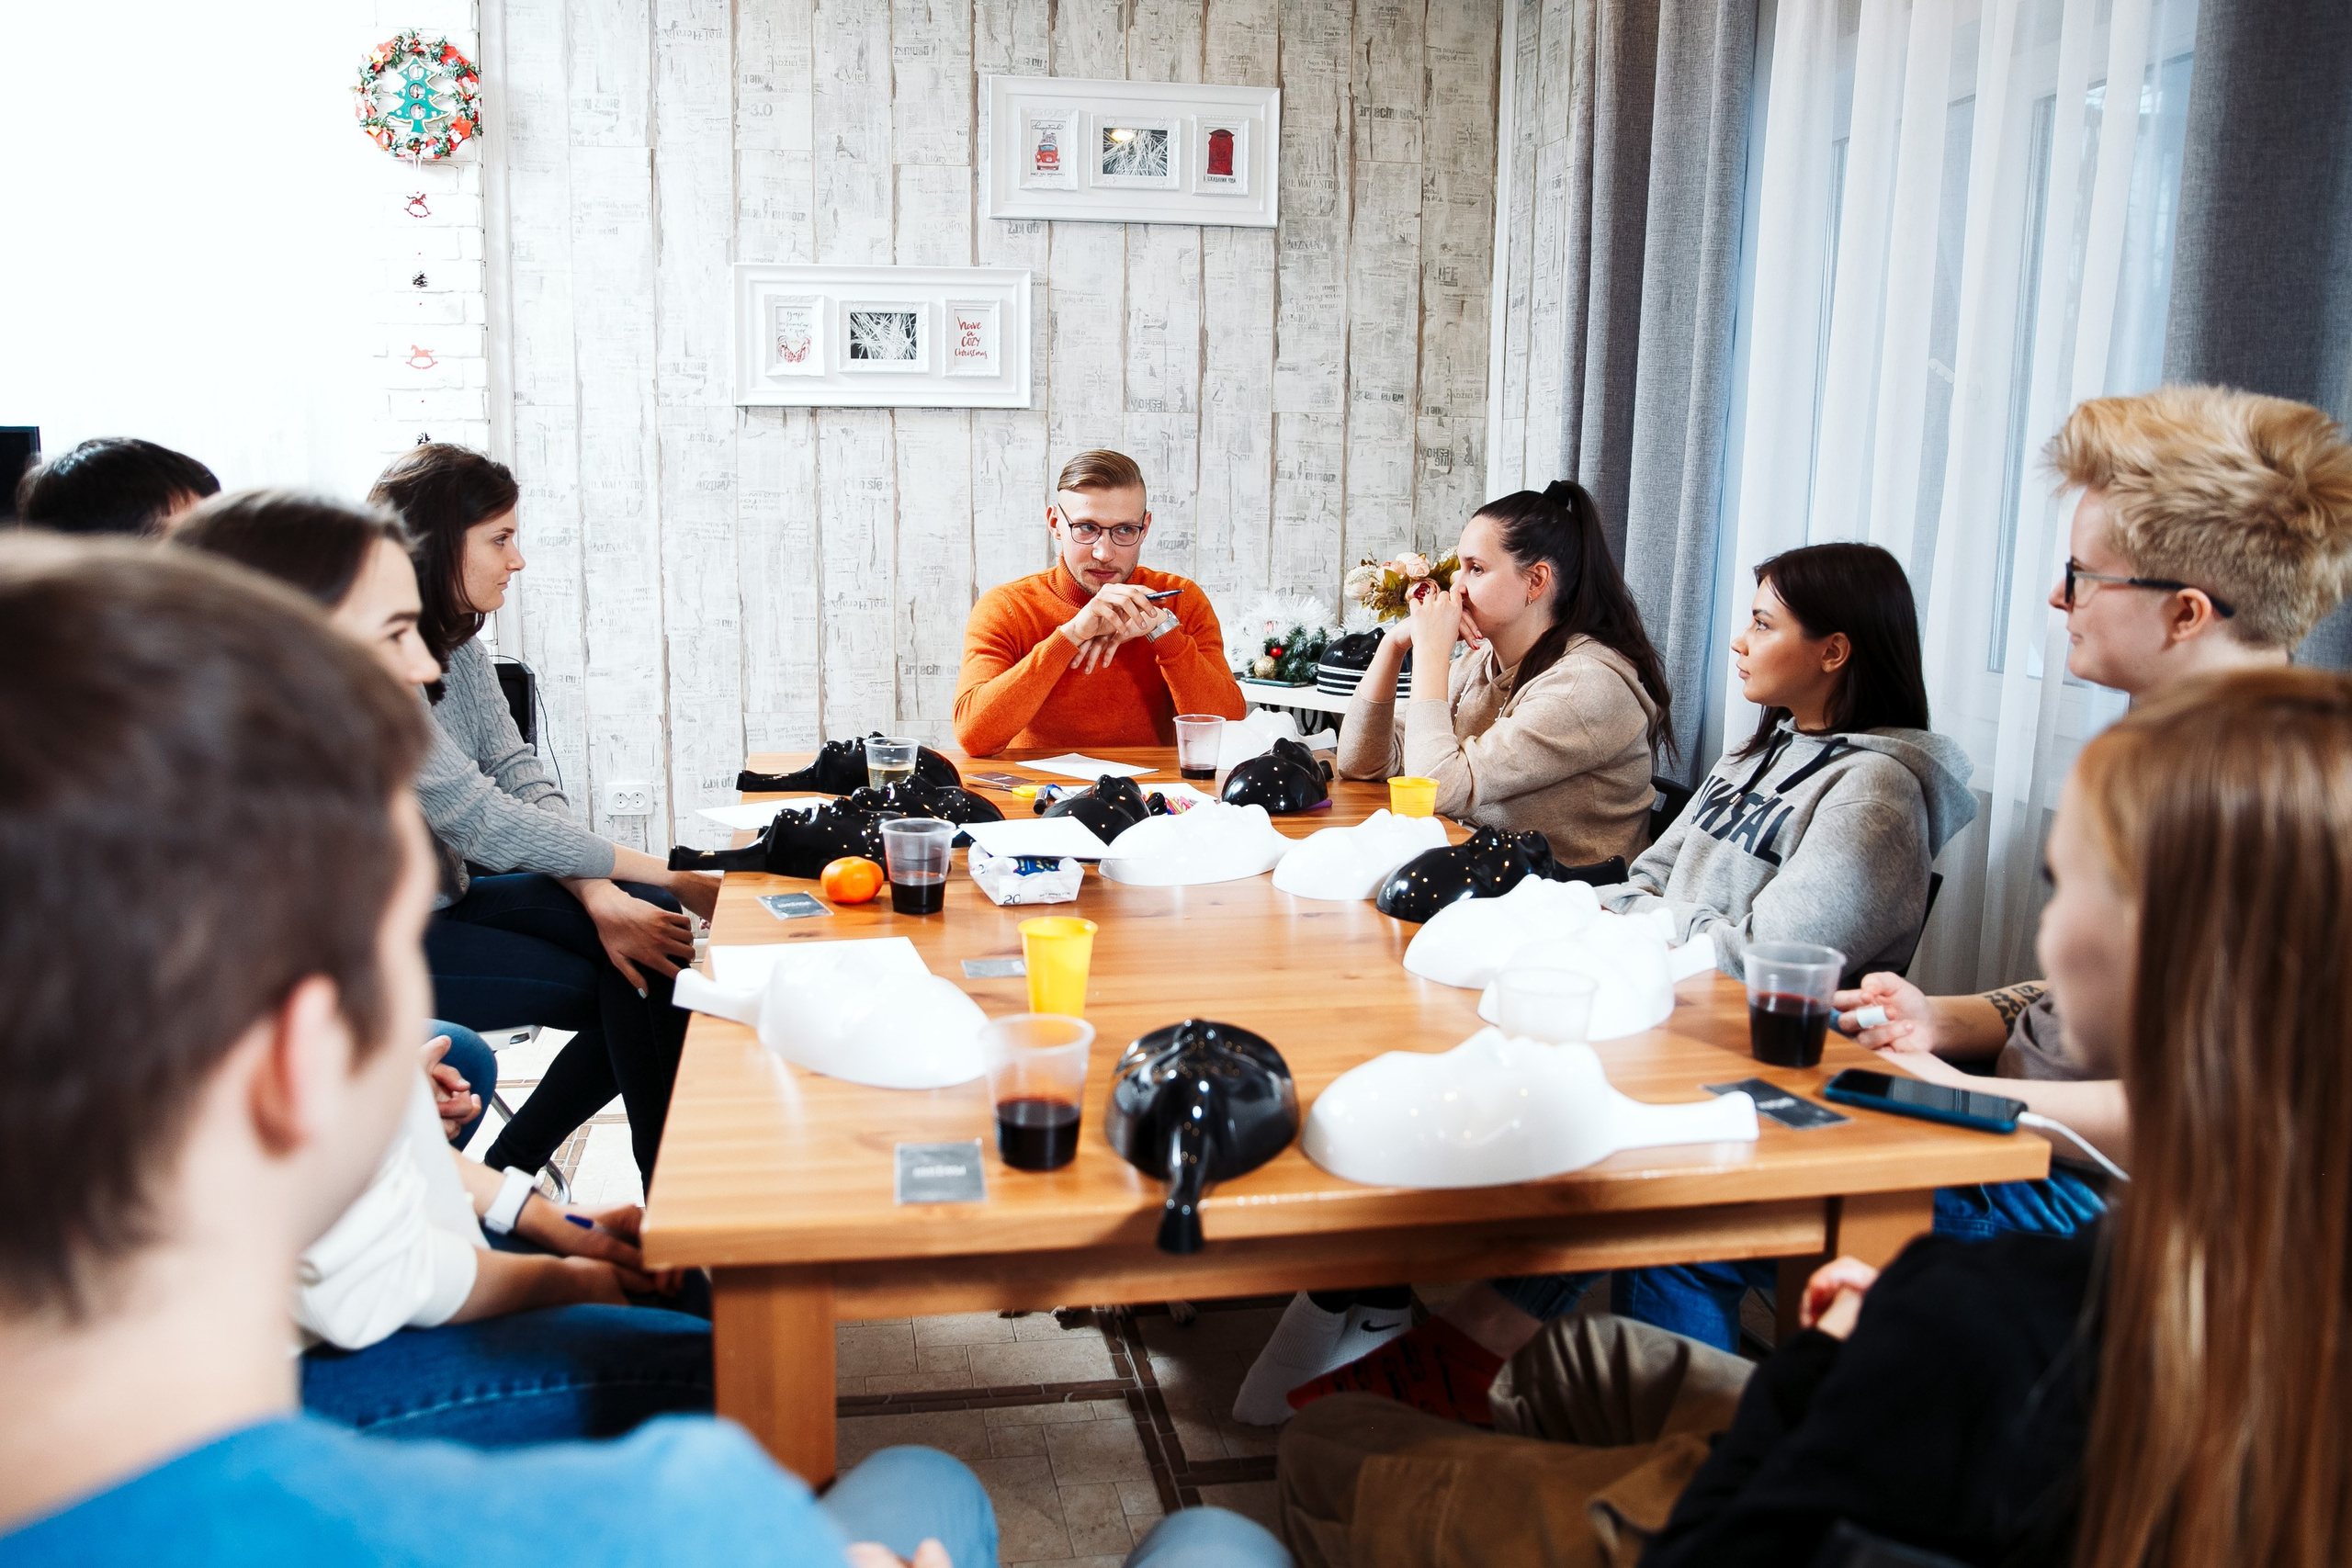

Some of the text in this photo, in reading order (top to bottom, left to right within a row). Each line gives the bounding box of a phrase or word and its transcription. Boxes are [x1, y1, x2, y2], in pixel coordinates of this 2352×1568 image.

[956, 316, 982, 331] have
[961, 335, 981, 347] COZY
[955, 347, 988, 360] Christmas
